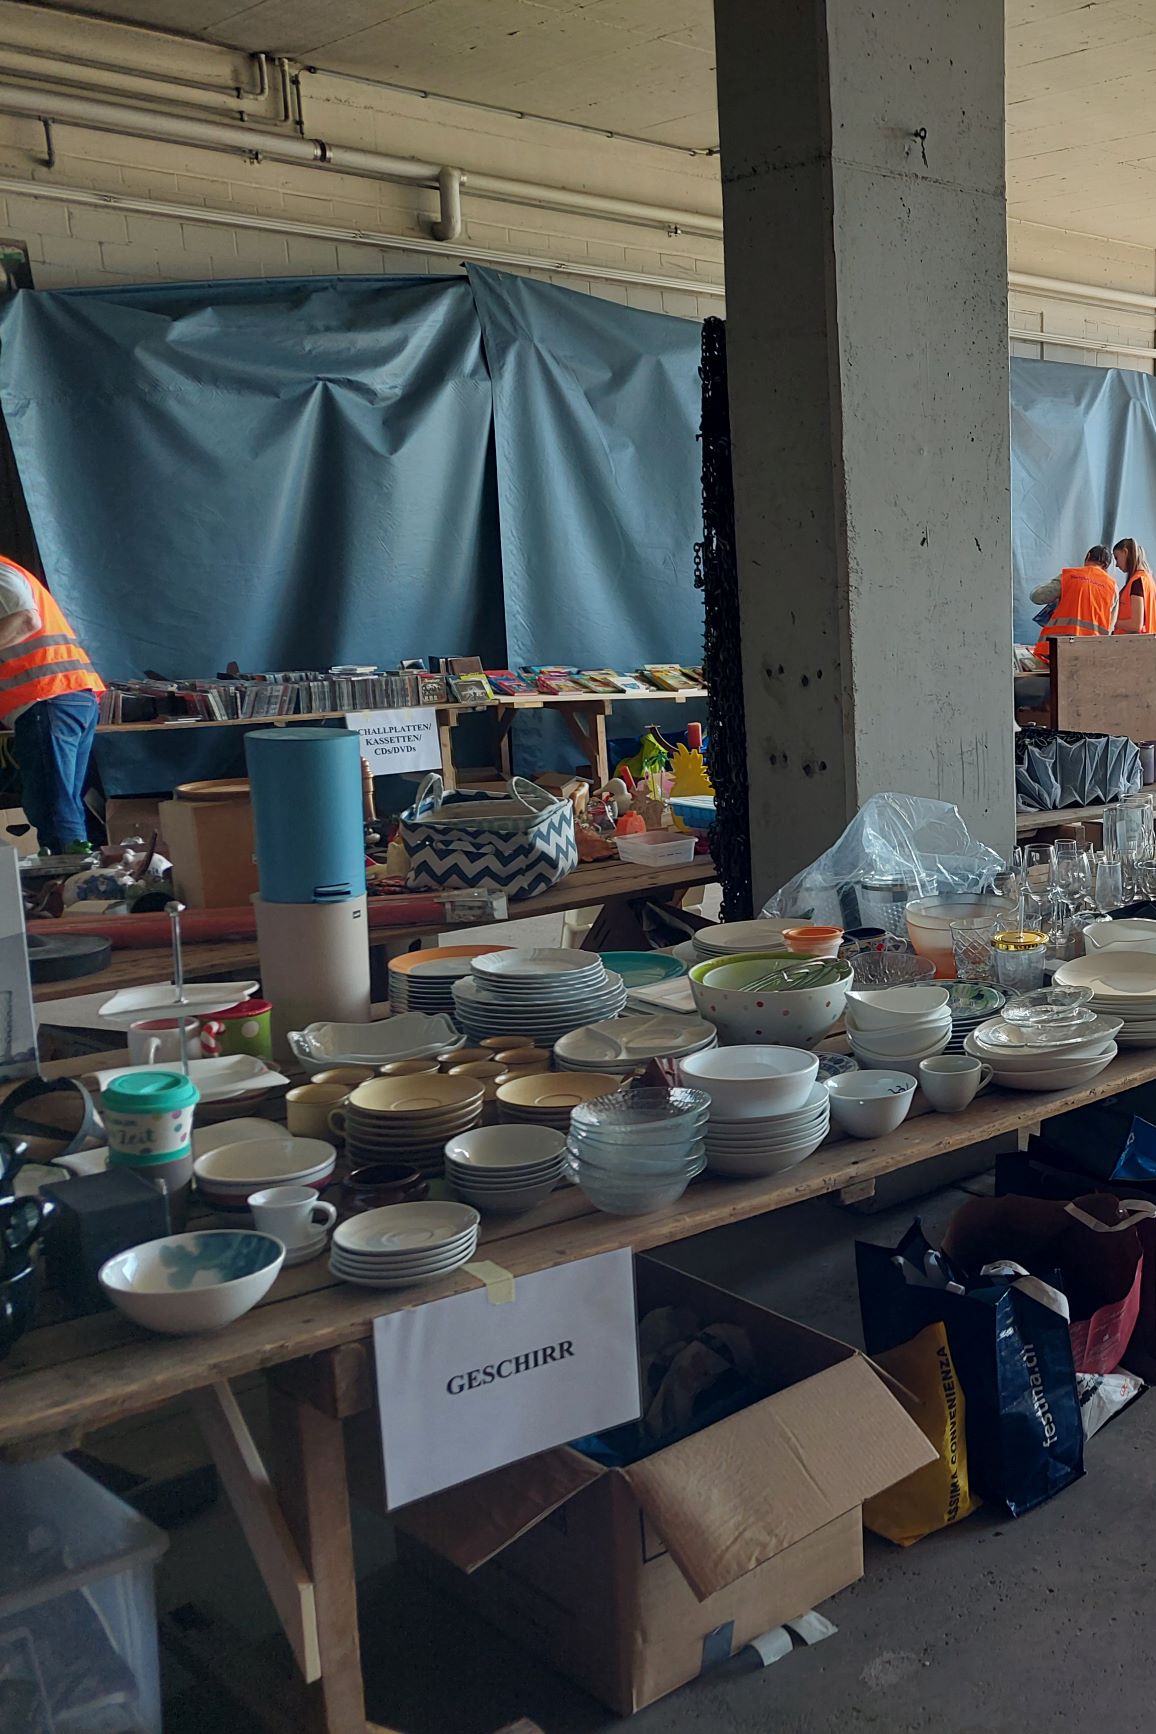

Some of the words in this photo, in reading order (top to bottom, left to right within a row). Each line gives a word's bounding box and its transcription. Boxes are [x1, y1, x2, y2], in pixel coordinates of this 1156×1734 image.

[358, 723, 432, 736] CHALLPLATTEN/
[365, 734, 422, 746] KASSETTEN/
[374, 745, 417, 756] CDs/DVDs
[446, 1340, 575, 1395] GESCHIRR
[937, 1346, 957, 1465] CONVENIENZA
